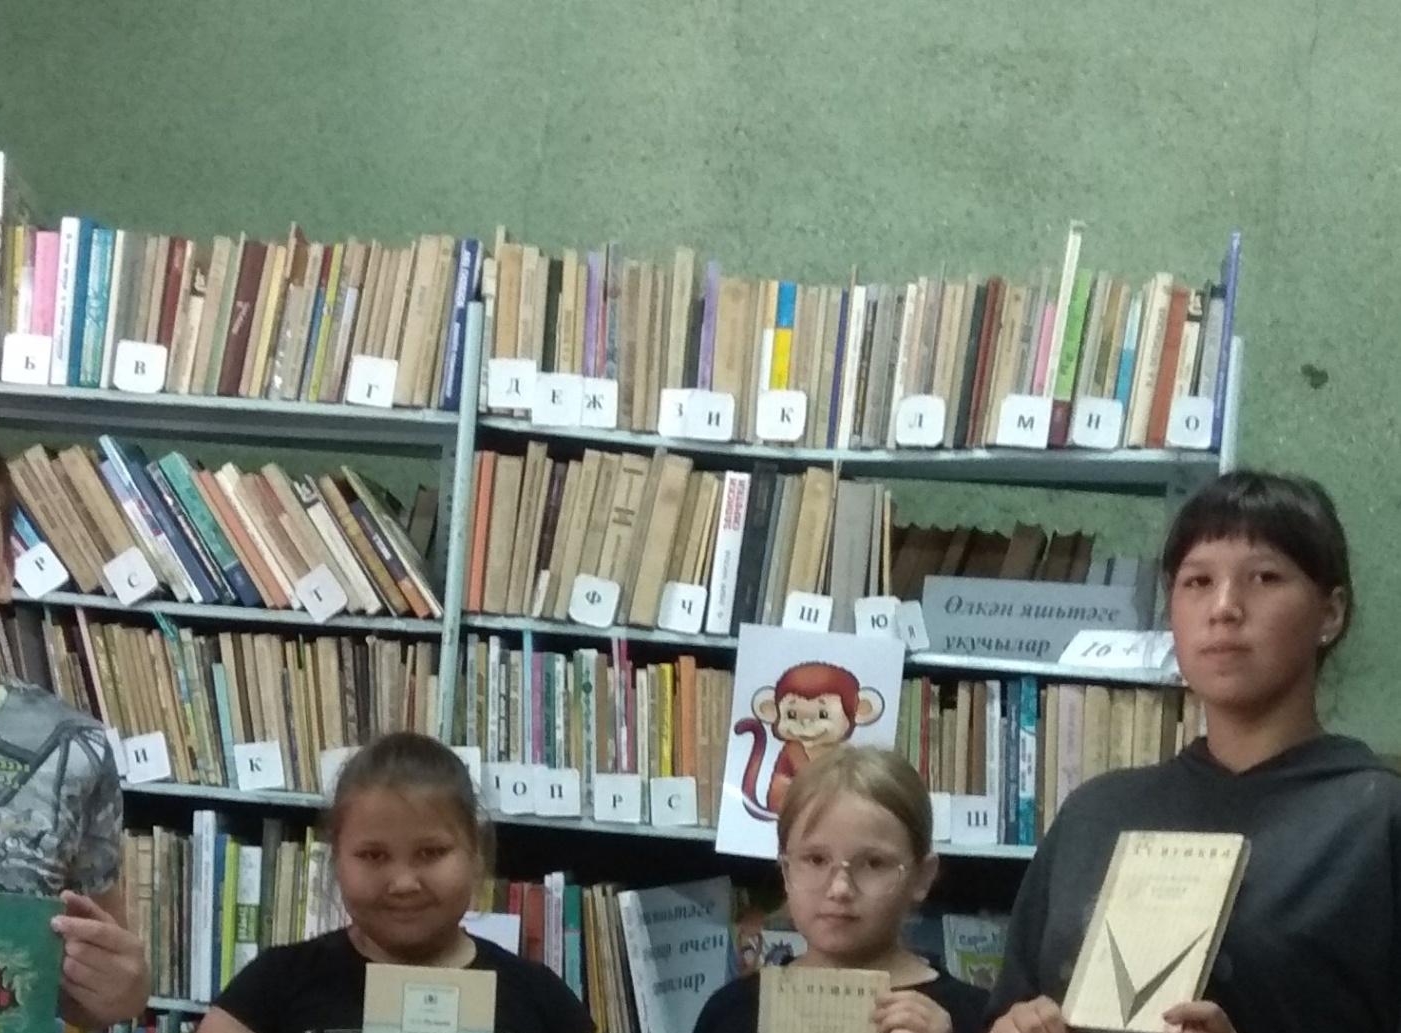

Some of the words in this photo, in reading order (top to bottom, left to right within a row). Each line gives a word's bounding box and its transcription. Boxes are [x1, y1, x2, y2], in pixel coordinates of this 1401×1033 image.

[24, 355, 36, 371] Б
[133, 360, 146, 376] В
[365, 382, 379, 399] Г
[505, 377, 522, 397] Д
[551, 389, 564, 405] Е
[584, 393, 603, 410] Ж
[706, 411, 720, 427] И
[780, 406, 795, 424] К
[908, 413, 924, 429] Л
[1016, 414, 1035, 431] М
[1184, 414, 1200, 431] О
[585, 589, 602, 605] Ф
[681, 599, 693, 615] Ч
[798, 604, 820, 624] Ш
[944, 594, 1014, 618] Өлкән
[870, 614, 889, 631] Ю
[133, 748, 149, 764] И
[249, 757, 262, 773] К
[512, 781, 527, 797] О
[549, 783, 564, 799] П
[611, 793, 624, 809] Р
[667, 793, 682, 810] С
